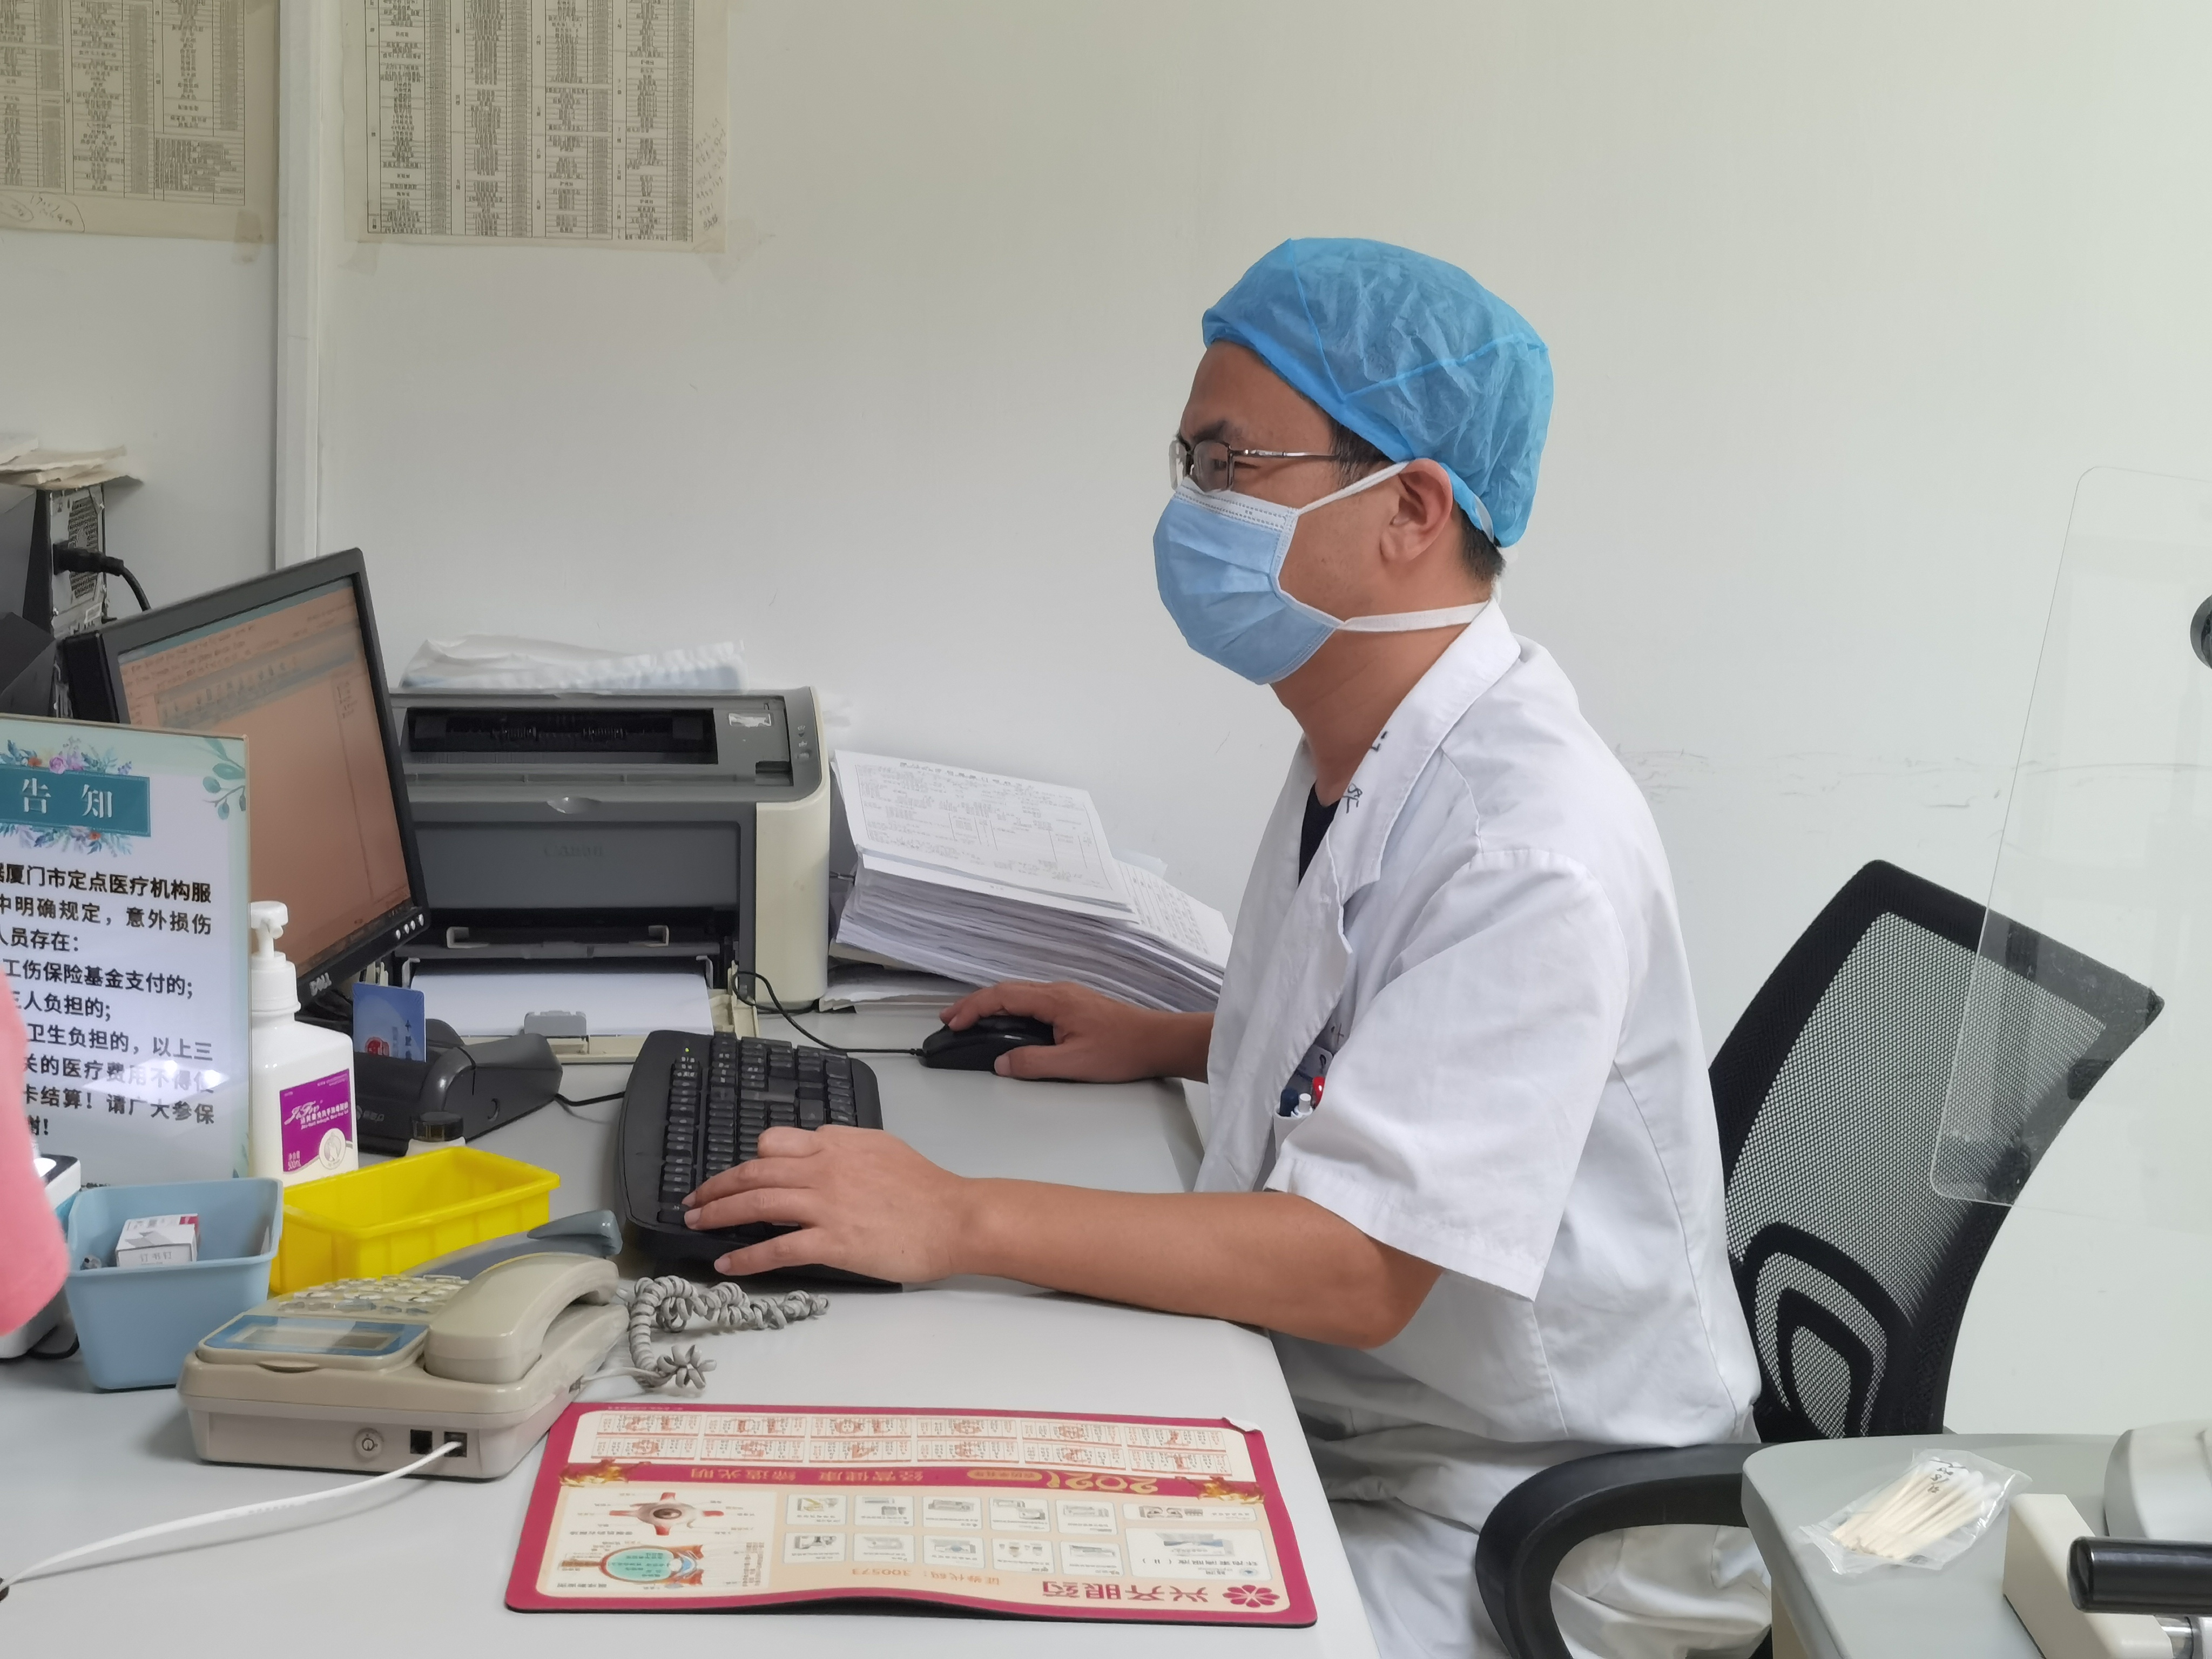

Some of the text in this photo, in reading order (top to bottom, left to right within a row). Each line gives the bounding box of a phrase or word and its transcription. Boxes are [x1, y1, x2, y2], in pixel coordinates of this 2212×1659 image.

[22, 778, 113, 819] 告知
[1046, 1469, 1159, 1494] 2021
[1043, 1580, 1209, 1604] 兴齐眼药
